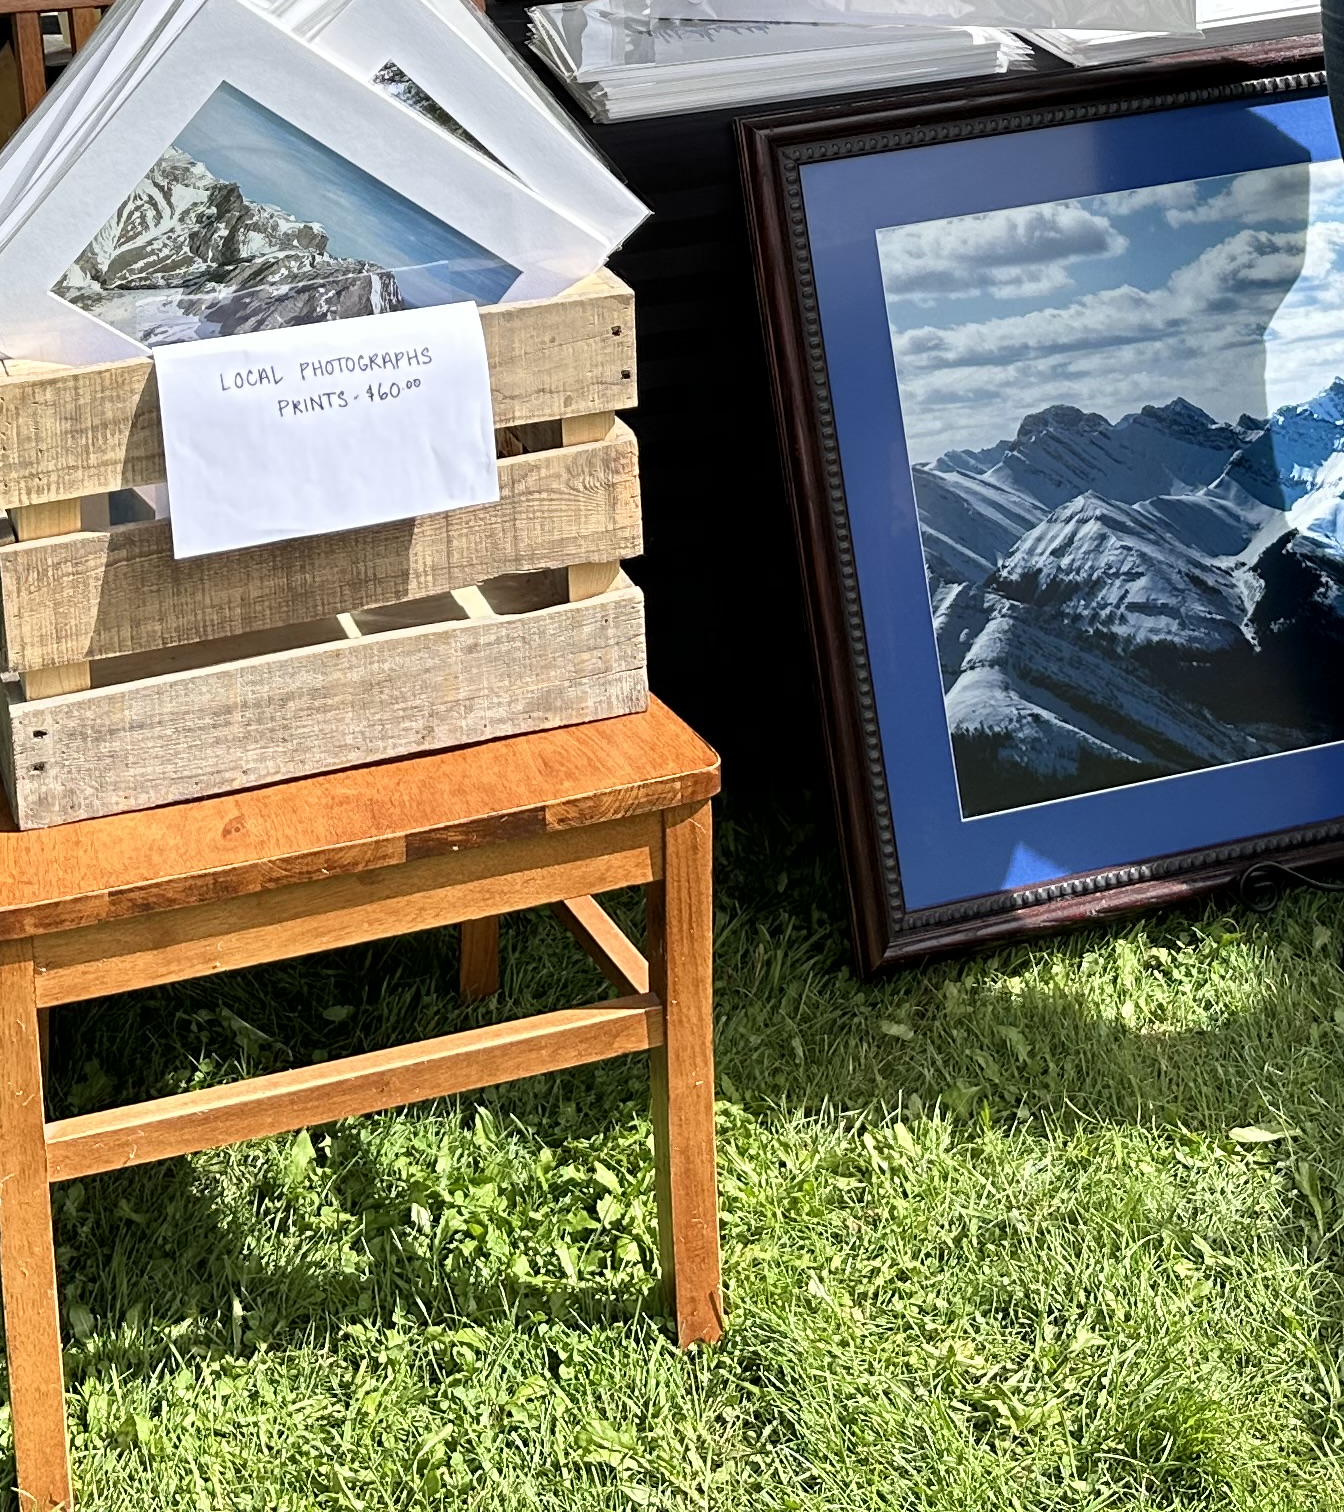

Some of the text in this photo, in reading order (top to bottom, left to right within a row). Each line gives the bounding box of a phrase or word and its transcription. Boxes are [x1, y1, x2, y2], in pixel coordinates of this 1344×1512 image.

[219, 347, 433, 391] LOCAL PHOTOGRAPHS
[277, 390, 349, 417] PRINTS
[366, 378, 422, 402] $60.00
